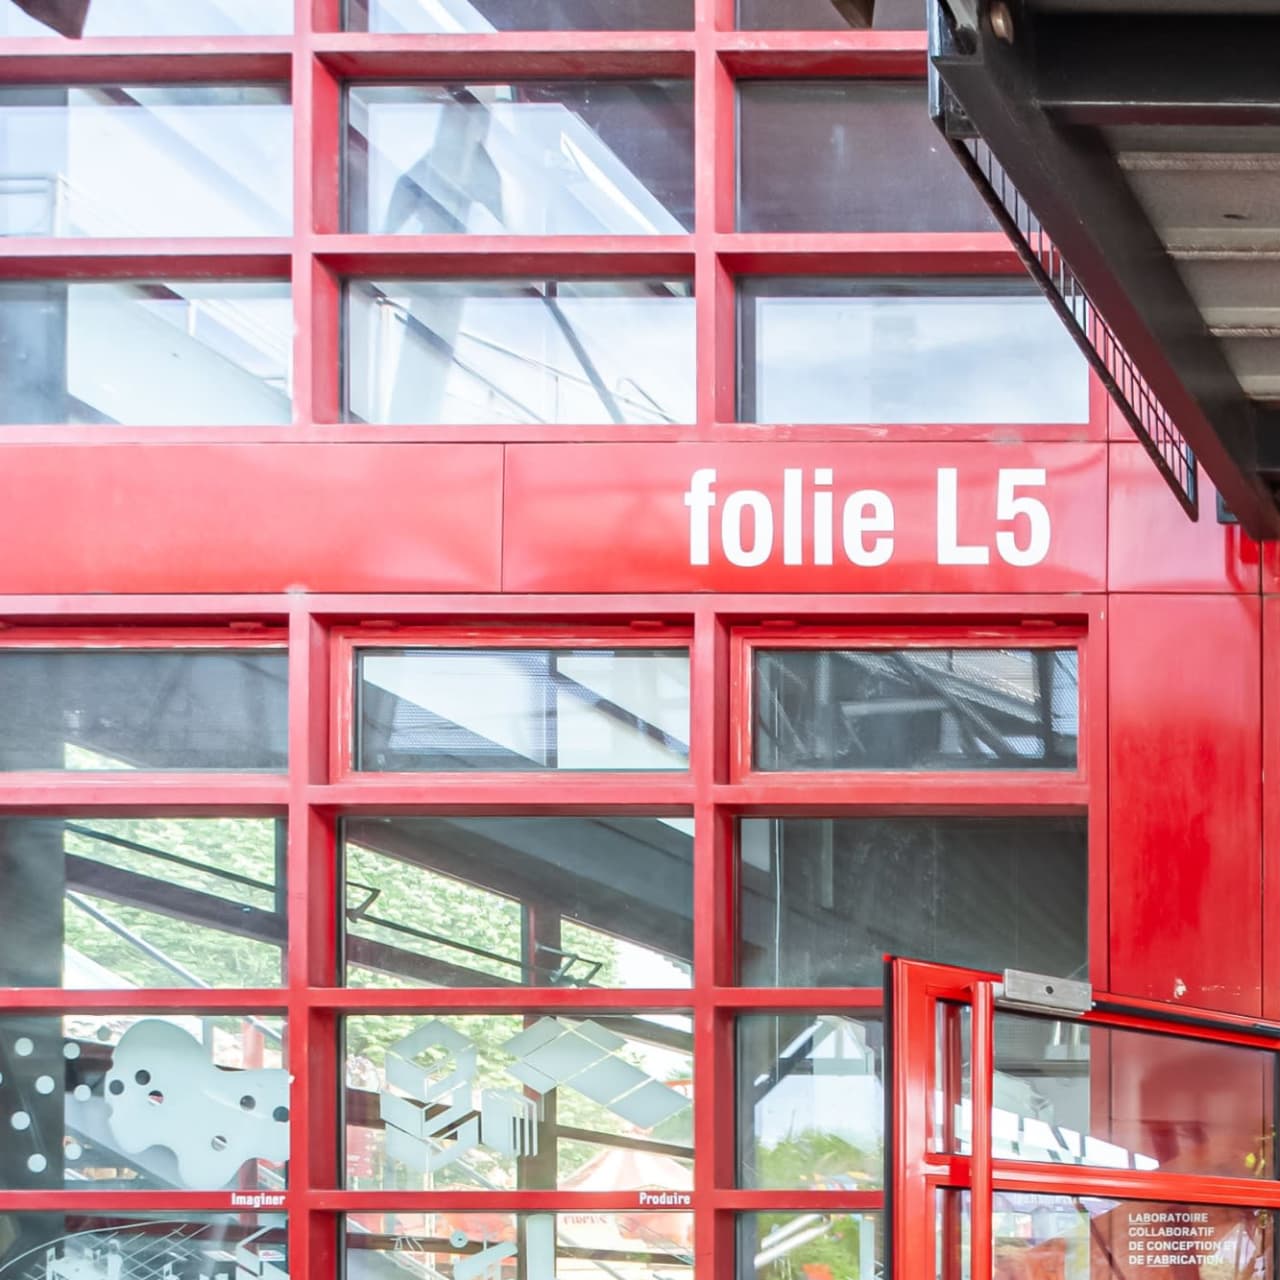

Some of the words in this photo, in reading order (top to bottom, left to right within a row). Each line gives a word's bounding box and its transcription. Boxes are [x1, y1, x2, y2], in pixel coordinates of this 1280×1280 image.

[683, 467, 895, 567] folie
[936, 467, 1052, 567] L5
[231, 1192, 287, 1208] Imaginer
[638, 1192, 692, 1205] Produire
[1128, 1213, 1209, 1222] LABORATOIRE
[1128, 1227, 1215, 1237] COLLABORATIF
[1128, 1241, 1145, 1251] DE
[1146, 1241, 1222, 1251] CONCEPTION
[1128, 1255, 1145, 1265] DE
[1146, 1255, 1224, 1265] FABRICATION
